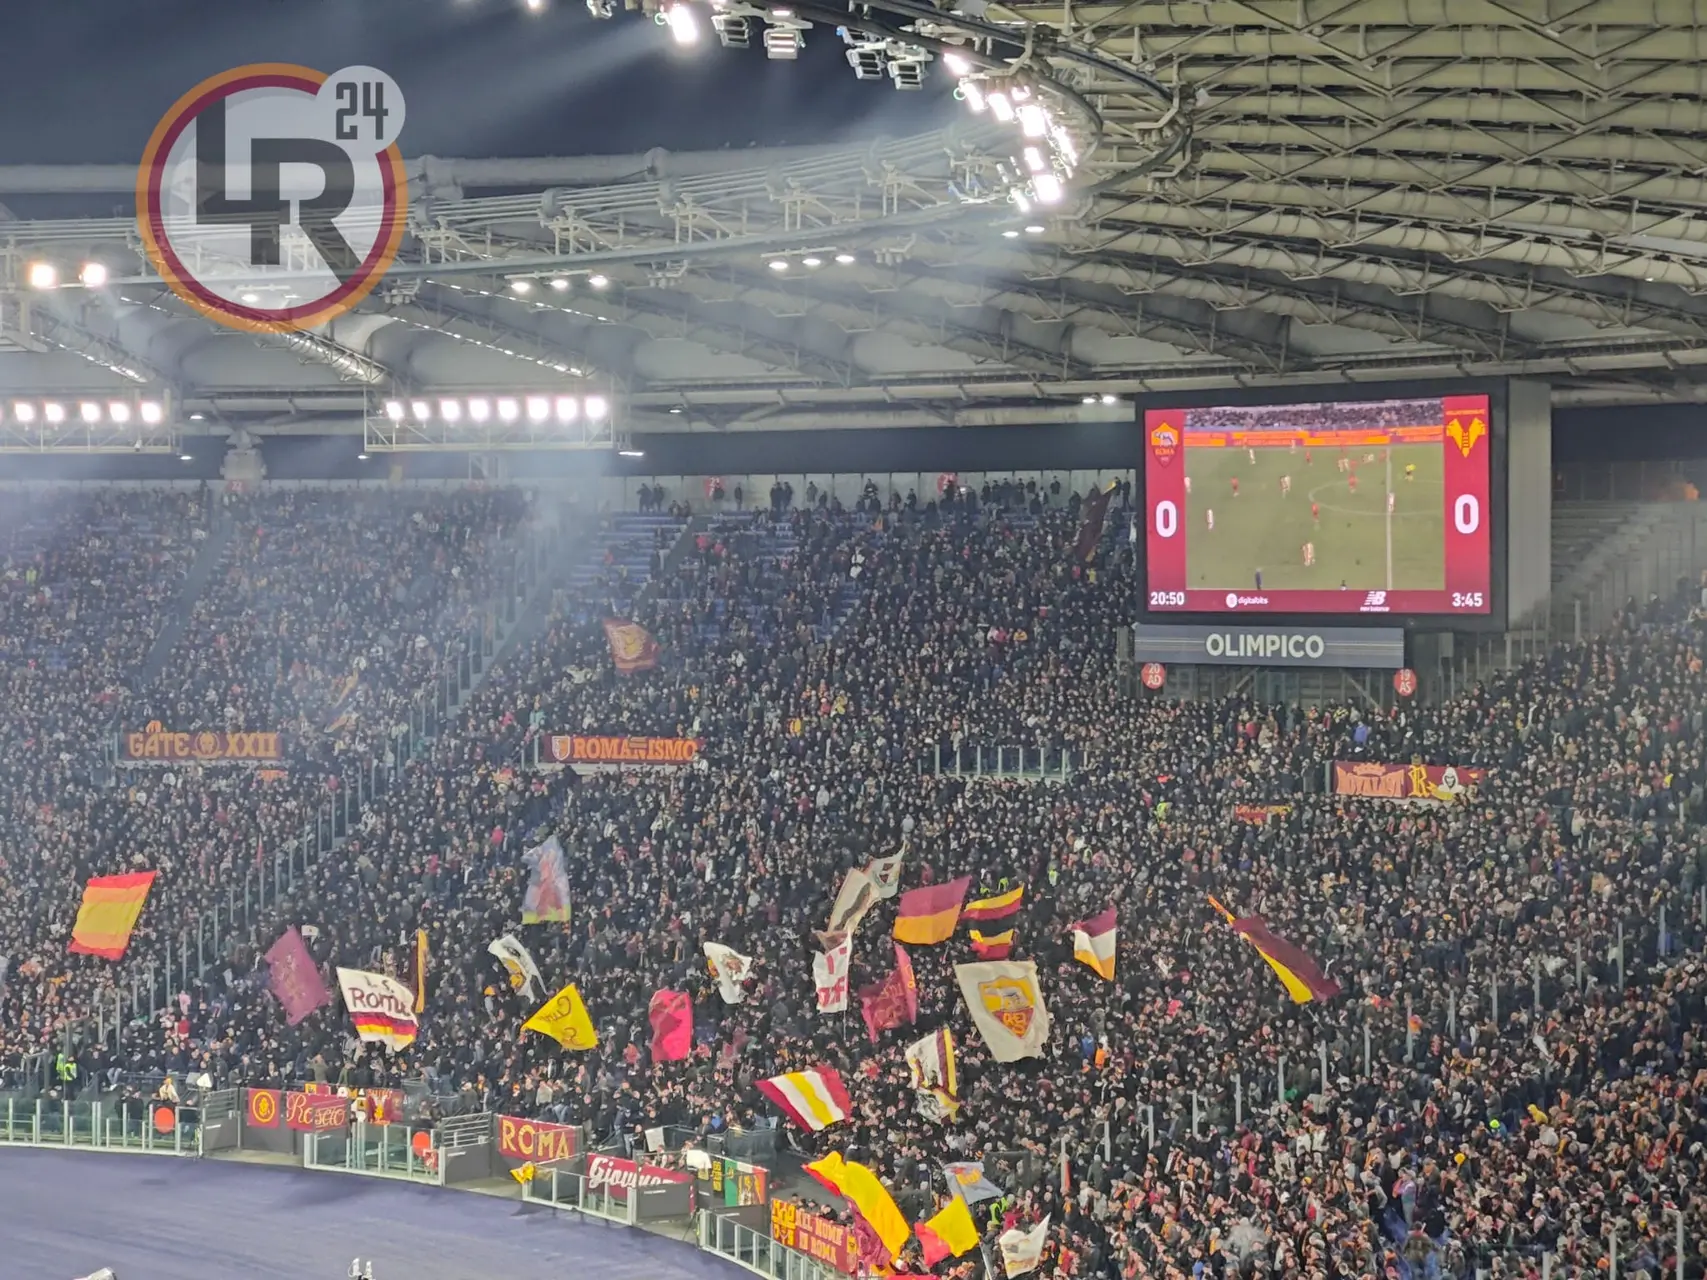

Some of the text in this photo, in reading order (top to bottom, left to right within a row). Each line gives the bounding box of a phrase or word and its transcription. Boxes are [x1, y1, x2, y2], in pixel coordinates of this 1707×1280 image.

[1155, 500, 1177, 537] 0
[1454, 494, 1479, 534] 0
[1150, 591, 1185, 605] 20:50
[1452, 592, 1483, 607] 3:45
[1206, 633, 1325, 658] OLIMPICO
[129, 732, 278, 757] GATE XXII
[502, 1119, 569, 1160] ROMA
